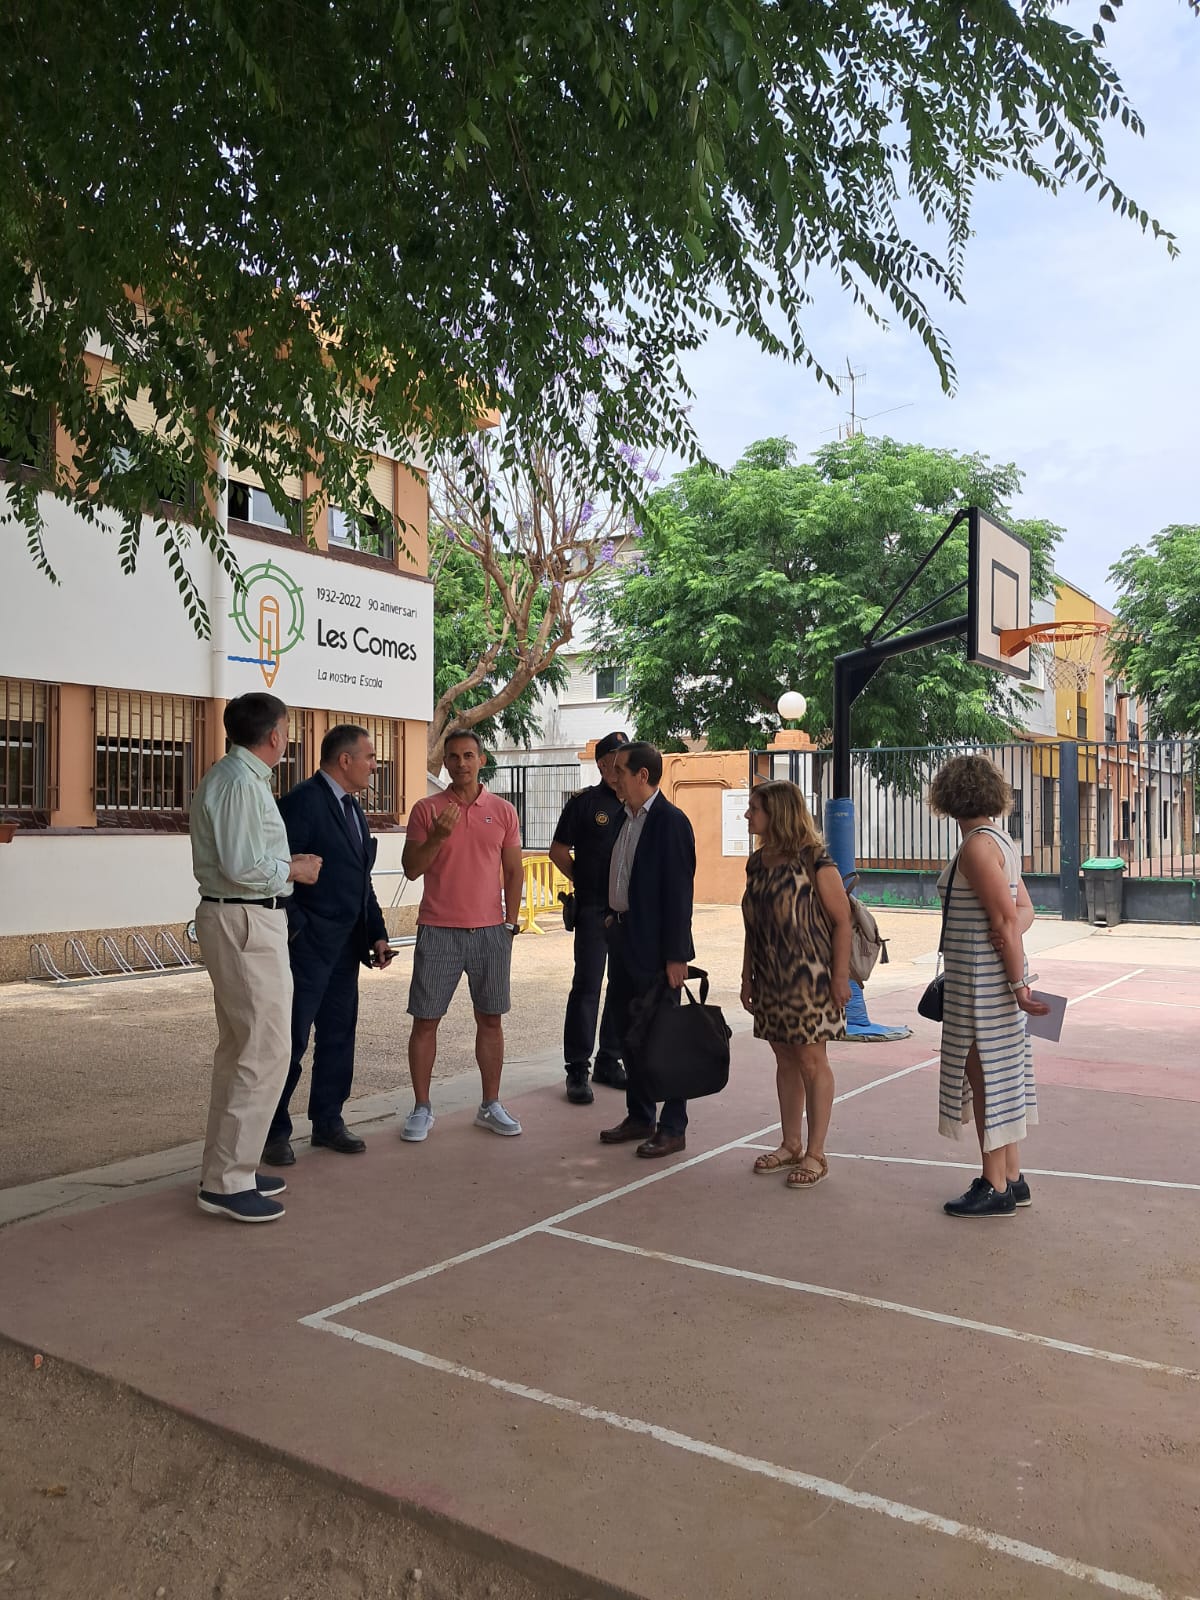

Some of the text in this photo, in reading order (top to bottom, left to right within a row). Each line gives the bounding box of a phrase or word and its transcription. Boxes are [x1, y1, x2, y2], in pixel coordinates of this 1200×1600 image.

[317, 587, 418, 618] 1932-2022 90 aniversari
[317, 618, 417, 662] Les Comes
[317, 668, 383, 689] La nostra Escola
